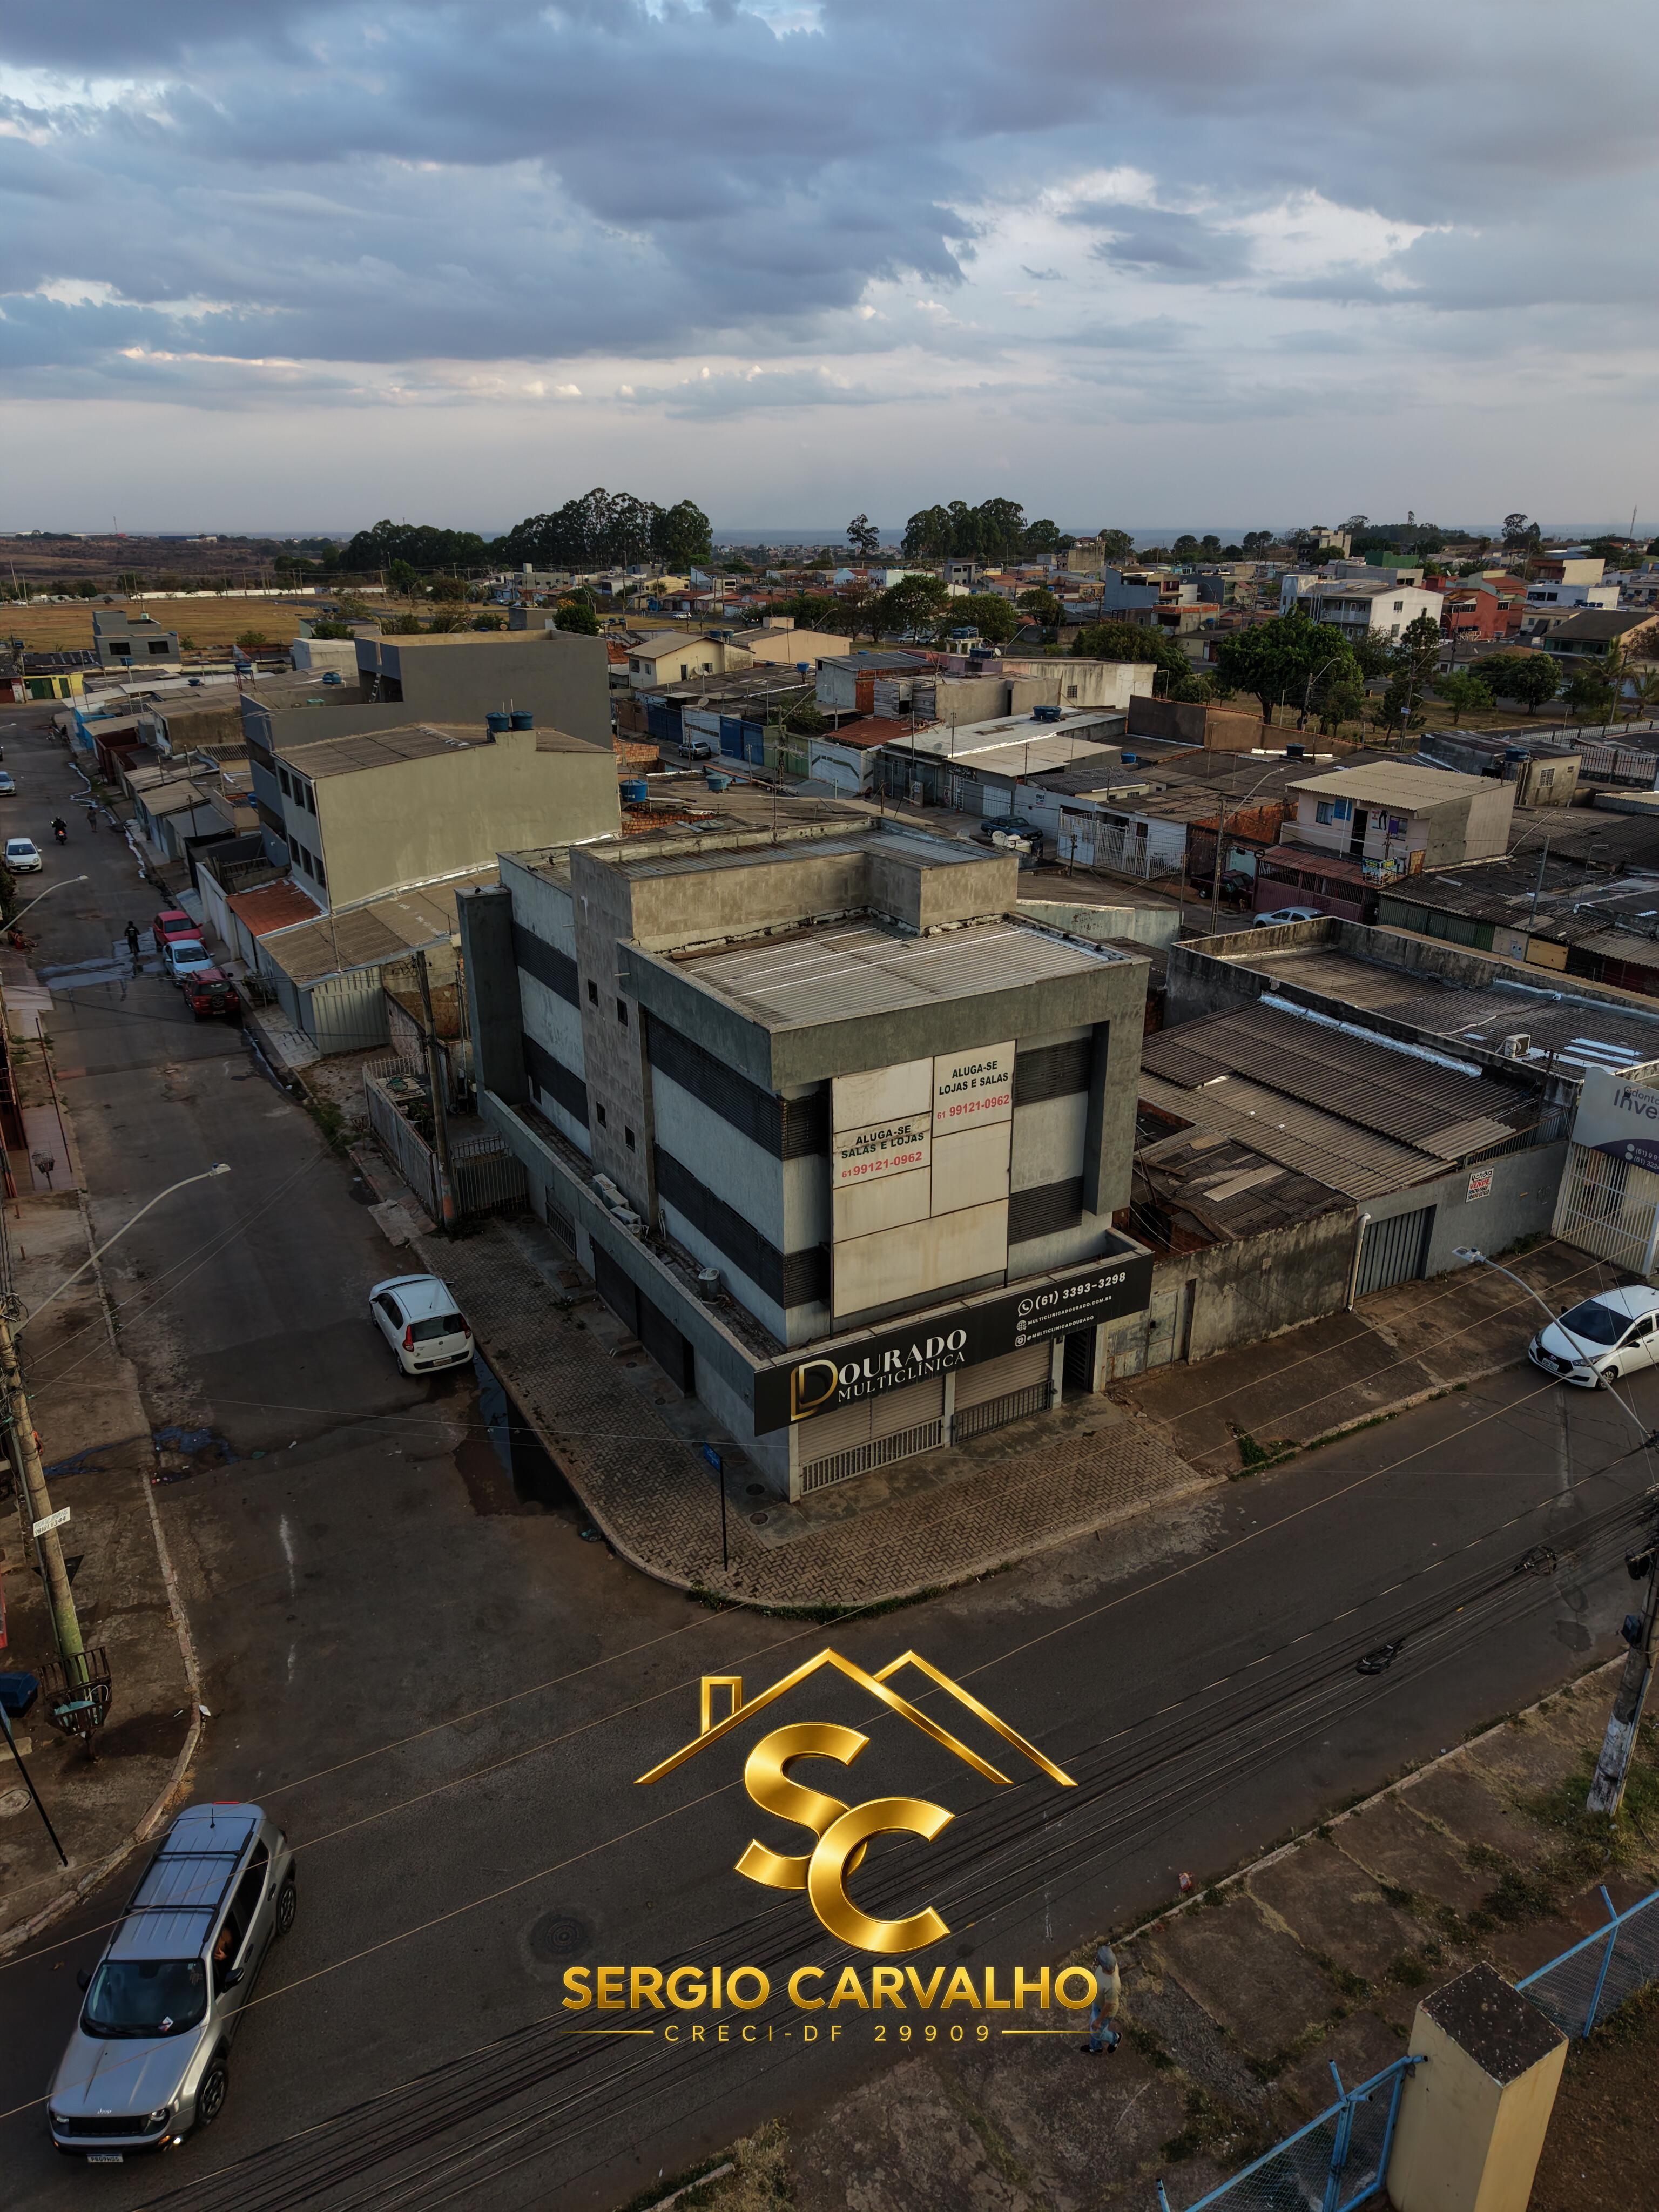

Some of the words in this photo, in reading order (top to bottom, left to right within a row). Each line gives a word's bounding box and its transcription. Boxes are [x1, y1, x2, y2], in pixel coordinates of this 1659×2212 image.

[952, 1061, 997, 1078] ALUGA-SE
[939, 1081, 968, 1095] LOJAS
[971, 1078, 976, 1088] E
[980, 1072, 1008, 1087] SALAS
[937, 1111, 946, 1120] 61
[949, 1094, 1010, 1117] 99121-0962
[1614, 1089, 1659, 1120] Inve
[841, 1144, 876, 1159] SALAS
[881, 1141, 887, 1150] E
[891, 1132, 924, 1148] LOJAS
[855, 1125, 911, 1145] ALUGA-SE
[842, 1169, 851, 1178] 61
[853, 1151, 922, 1176] 99121-0962
[1634, 1156, 1645, 1165] (61)
[1636, 1148, 1647, 1157] (61)
[1470, 1178, 1490, 1190] VENDE
[1035, 1290, 1058, 1310] (61)
[1062, 1272, 1126, 1299] 3393-3298
[1028, 1296, 1112, 1325] MULTICLINICADOURADO.COM.BR
[1027, 1316, 1094, 1341] @MULTICLINICADOURADO
[838, 1351, 965, 1403] MULTICLÍNICA
